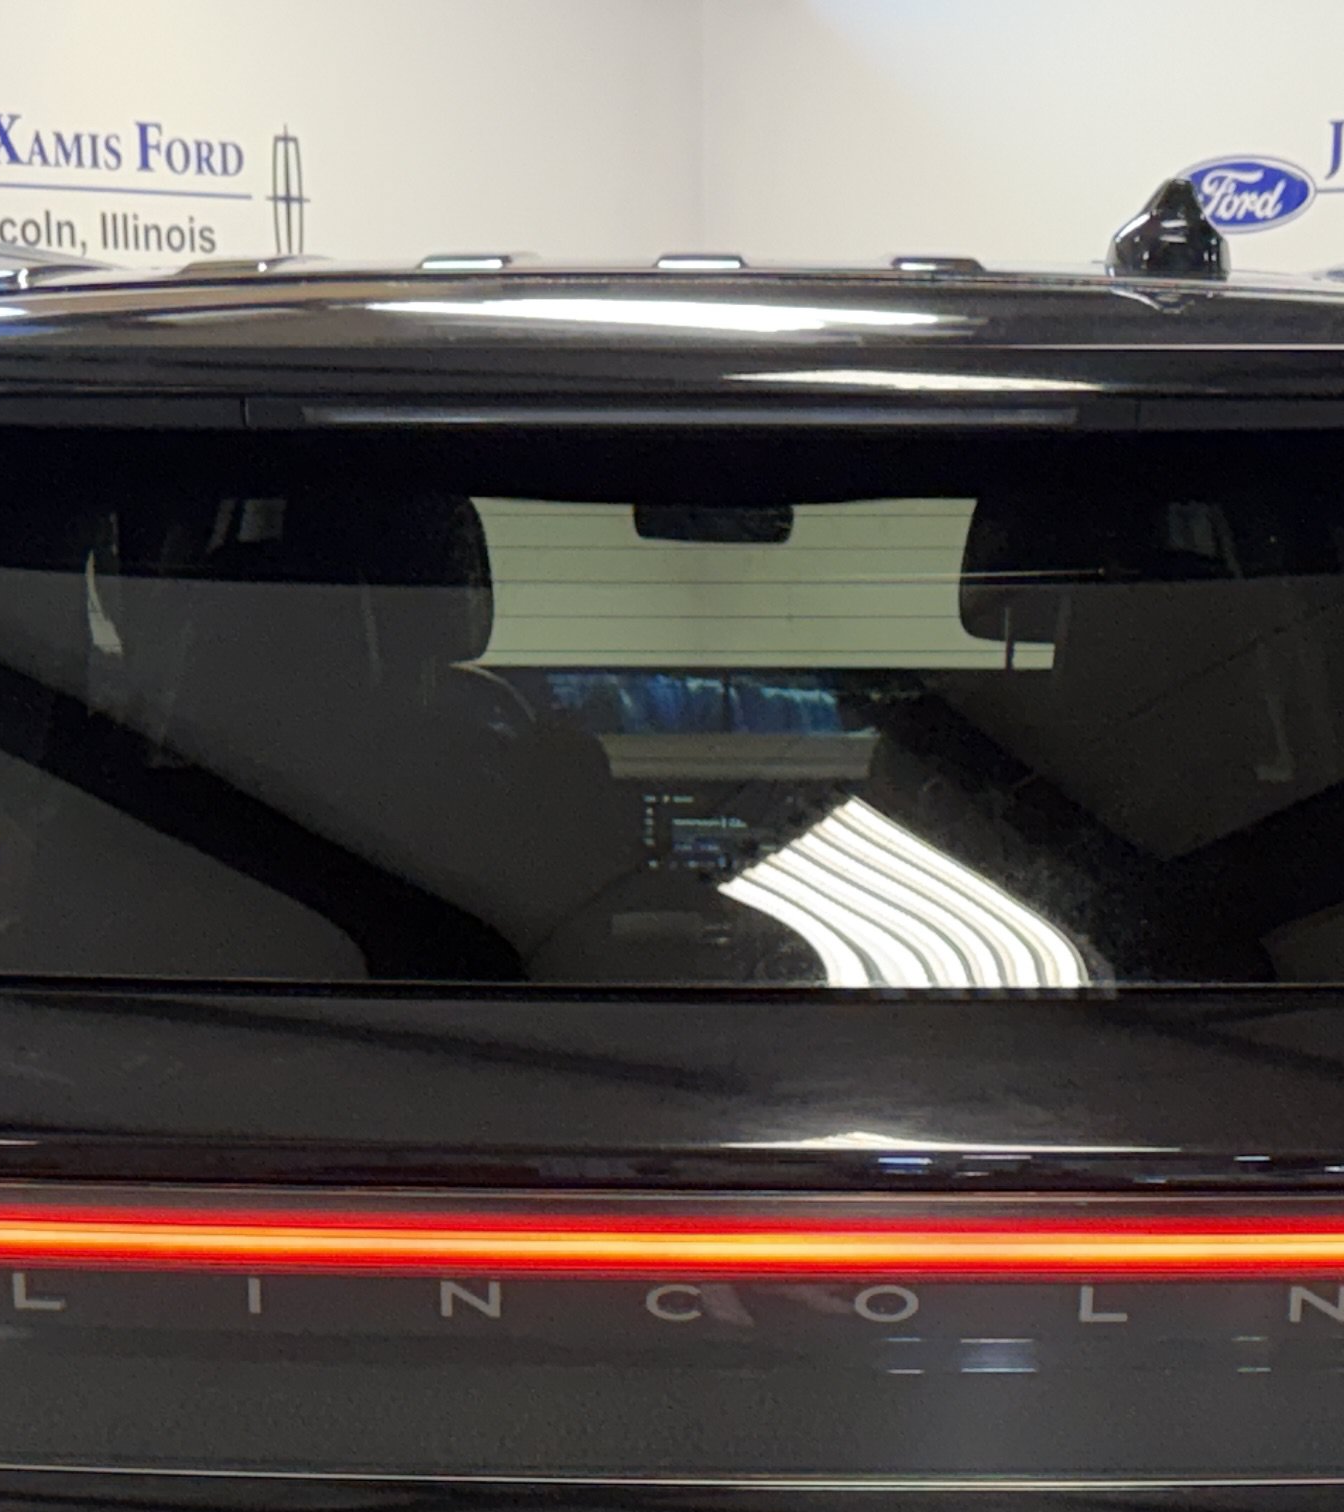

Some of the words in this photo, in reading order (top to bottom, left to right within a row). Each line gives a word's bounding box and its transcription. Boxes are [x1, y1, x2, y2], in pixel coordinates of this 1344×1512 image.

[135, 121, 244, 177] FORD
[1200, 170, 1282, 220] Ford
[101, 211, 216, 253] Illinois
